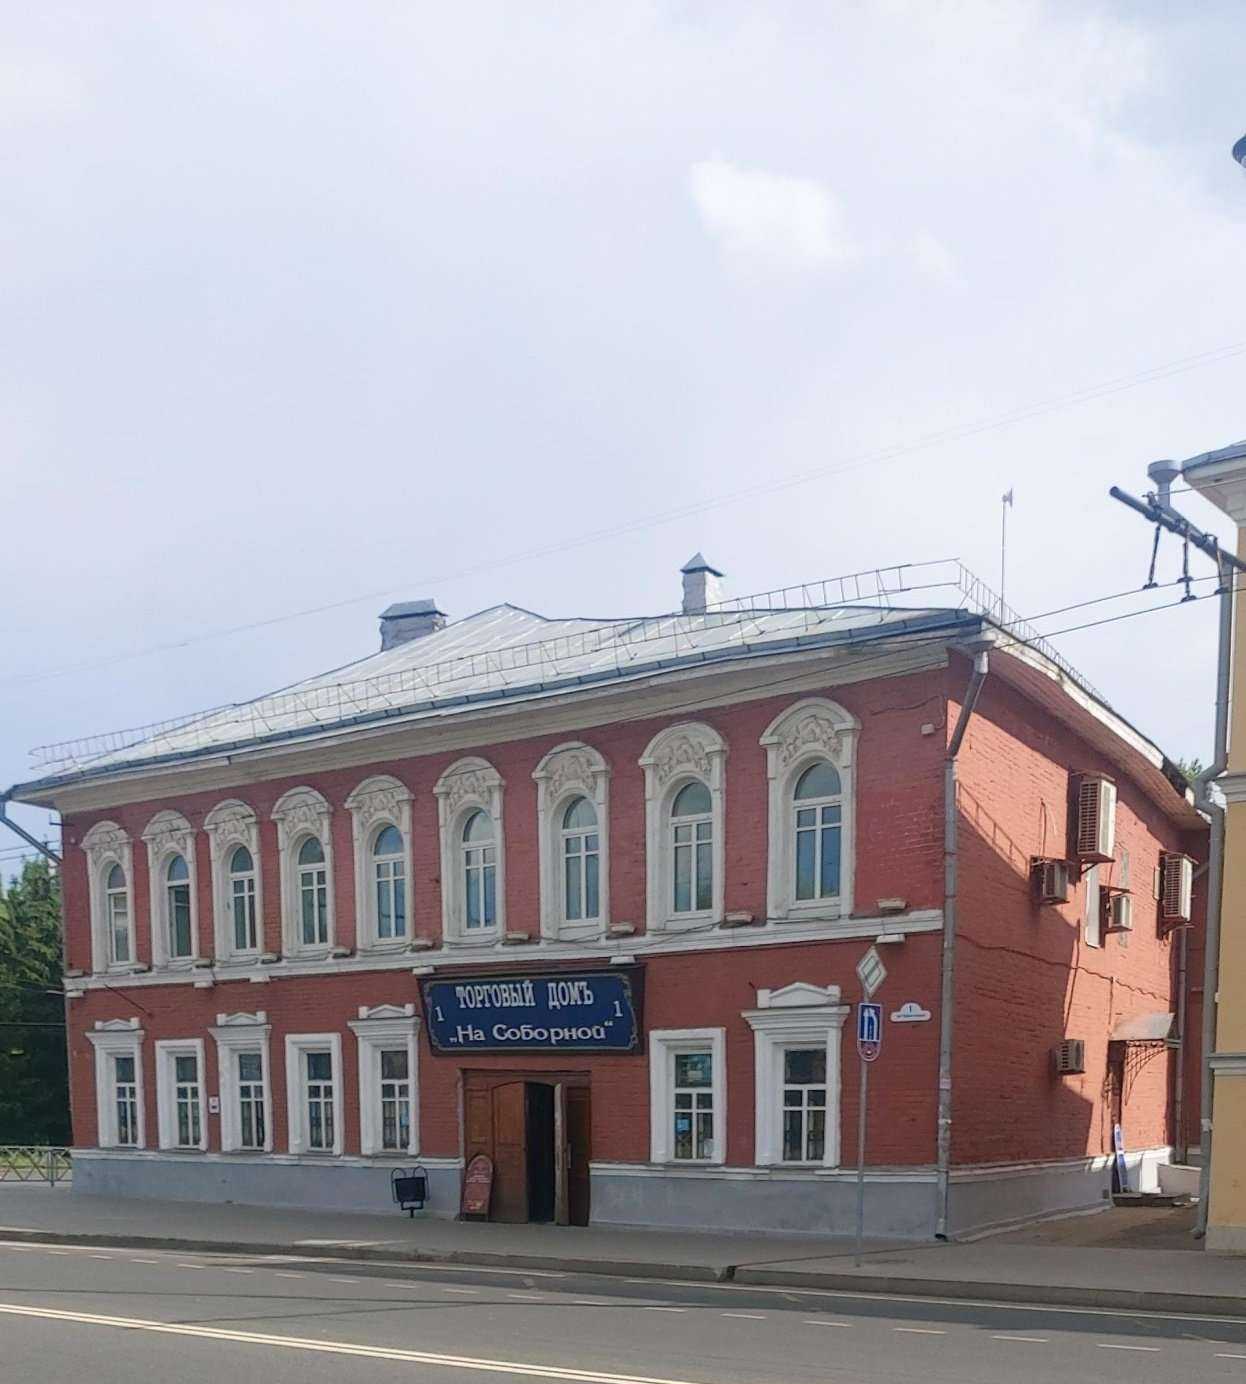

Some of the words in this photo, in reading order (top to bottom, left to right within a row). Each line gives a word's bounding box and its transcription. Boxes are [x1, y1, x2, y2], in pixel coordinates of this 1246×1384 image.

[455, 980, 536, 1009] ТОРГОВЫЙ
[547, 981, 594, 1010] ДОМЪ
[435, 1006, 445, 1022] 1
[613, 1001, 623, 1017] 1
